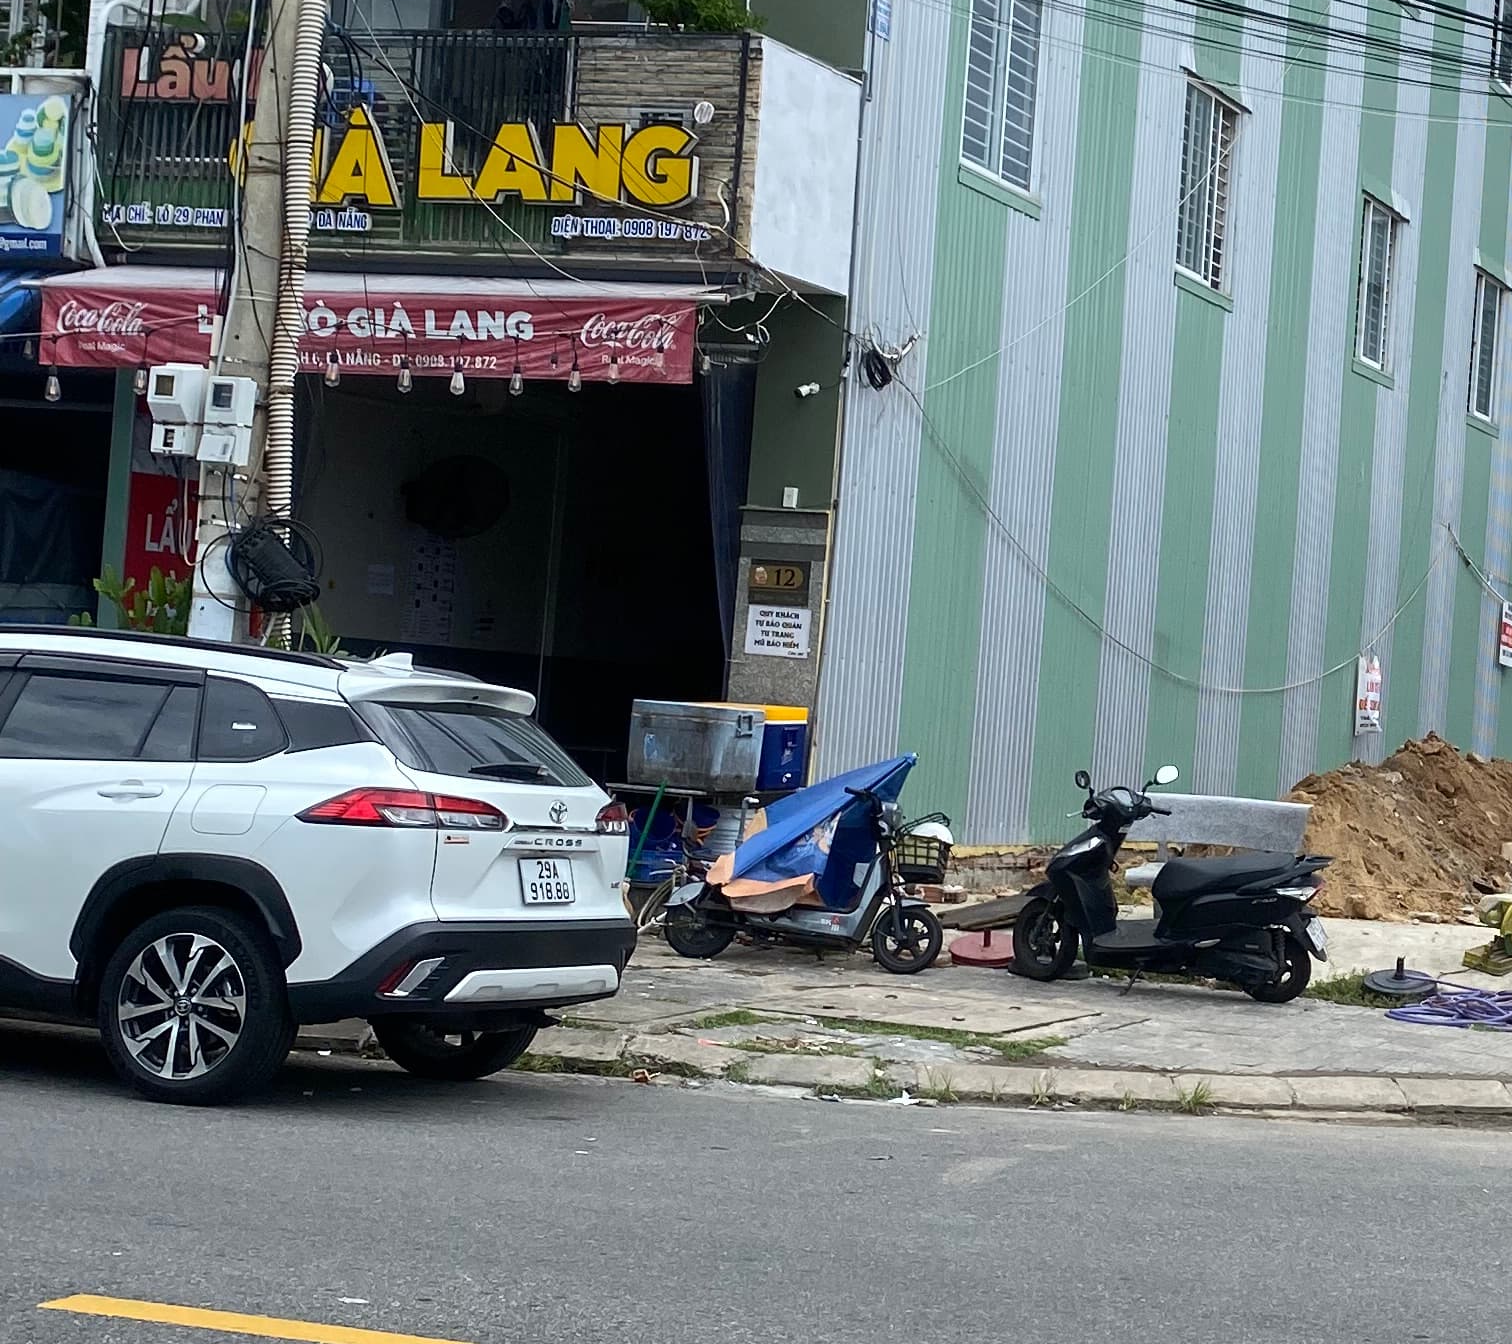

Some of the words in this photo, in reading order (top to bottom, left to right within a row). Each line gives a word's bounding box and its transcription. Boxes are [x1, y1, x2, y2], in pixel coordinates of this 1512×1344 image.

[120, 31, 230, 100] Lẩu
[417, 122, 700, 205] LANG
[175, 207, 190, 223] 29
[194, 209, 224, 226] PHAN
[624, 220, 654, 236] 0908
[347, 301, 416, 340] GIÀ
[424, 309, 534, 341] LANG
[774, 568, 796, 587] 12
[534, 838, 583, 847] CROSS
[536, 860, 560, 879] 29A
